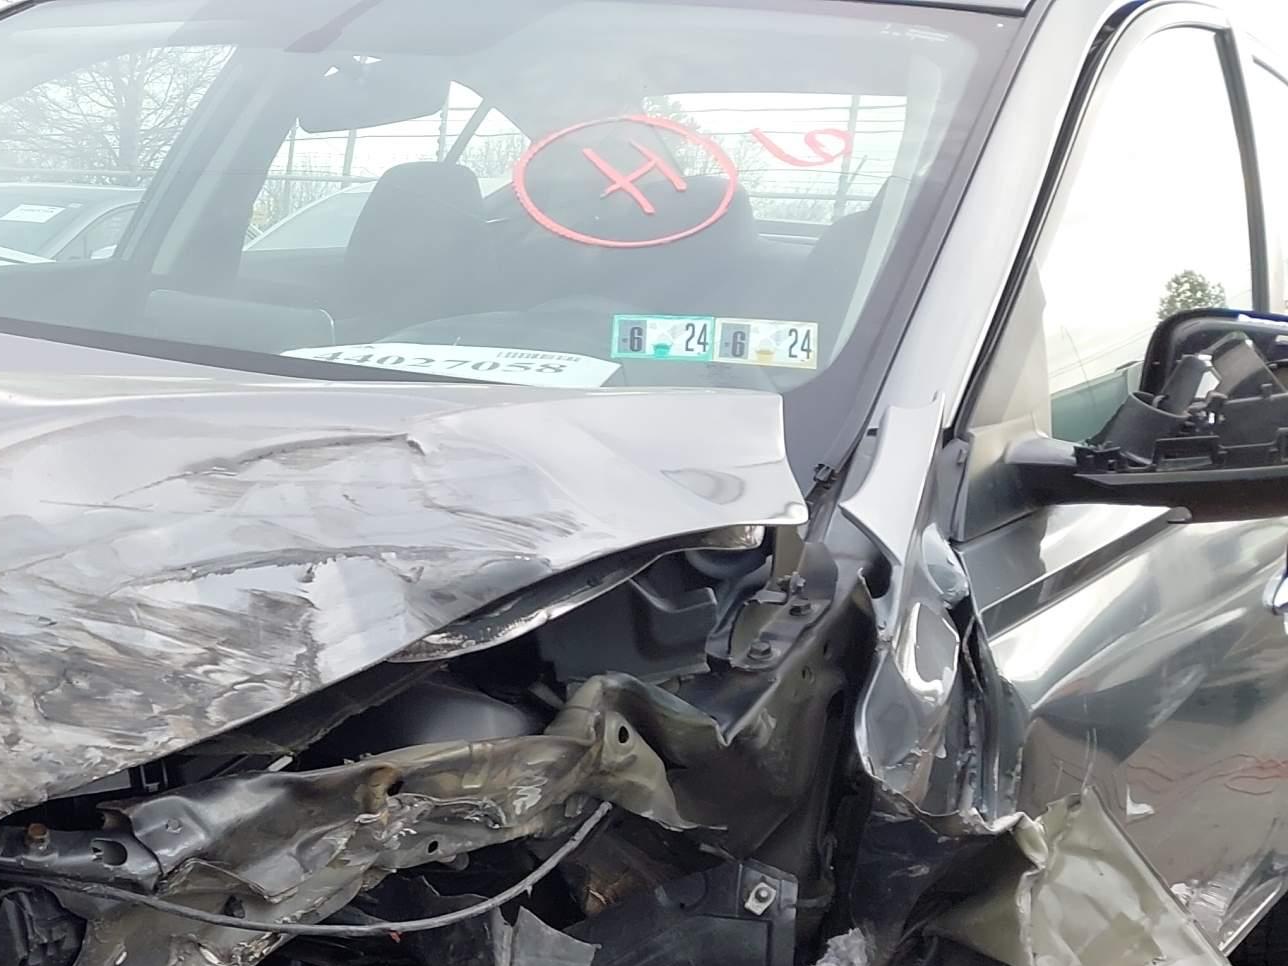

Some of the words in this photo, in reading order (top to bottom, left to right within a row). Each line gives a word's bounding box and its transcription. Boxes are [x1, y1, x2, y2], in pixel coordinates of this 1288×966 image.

[628, 326, 643, 353] 6
[684, 323, 709, 353] 24
[730, 330, 746, 358] 6
[788, 328, 812, 360] 24
[313, 351, 569, 374] 44027058
